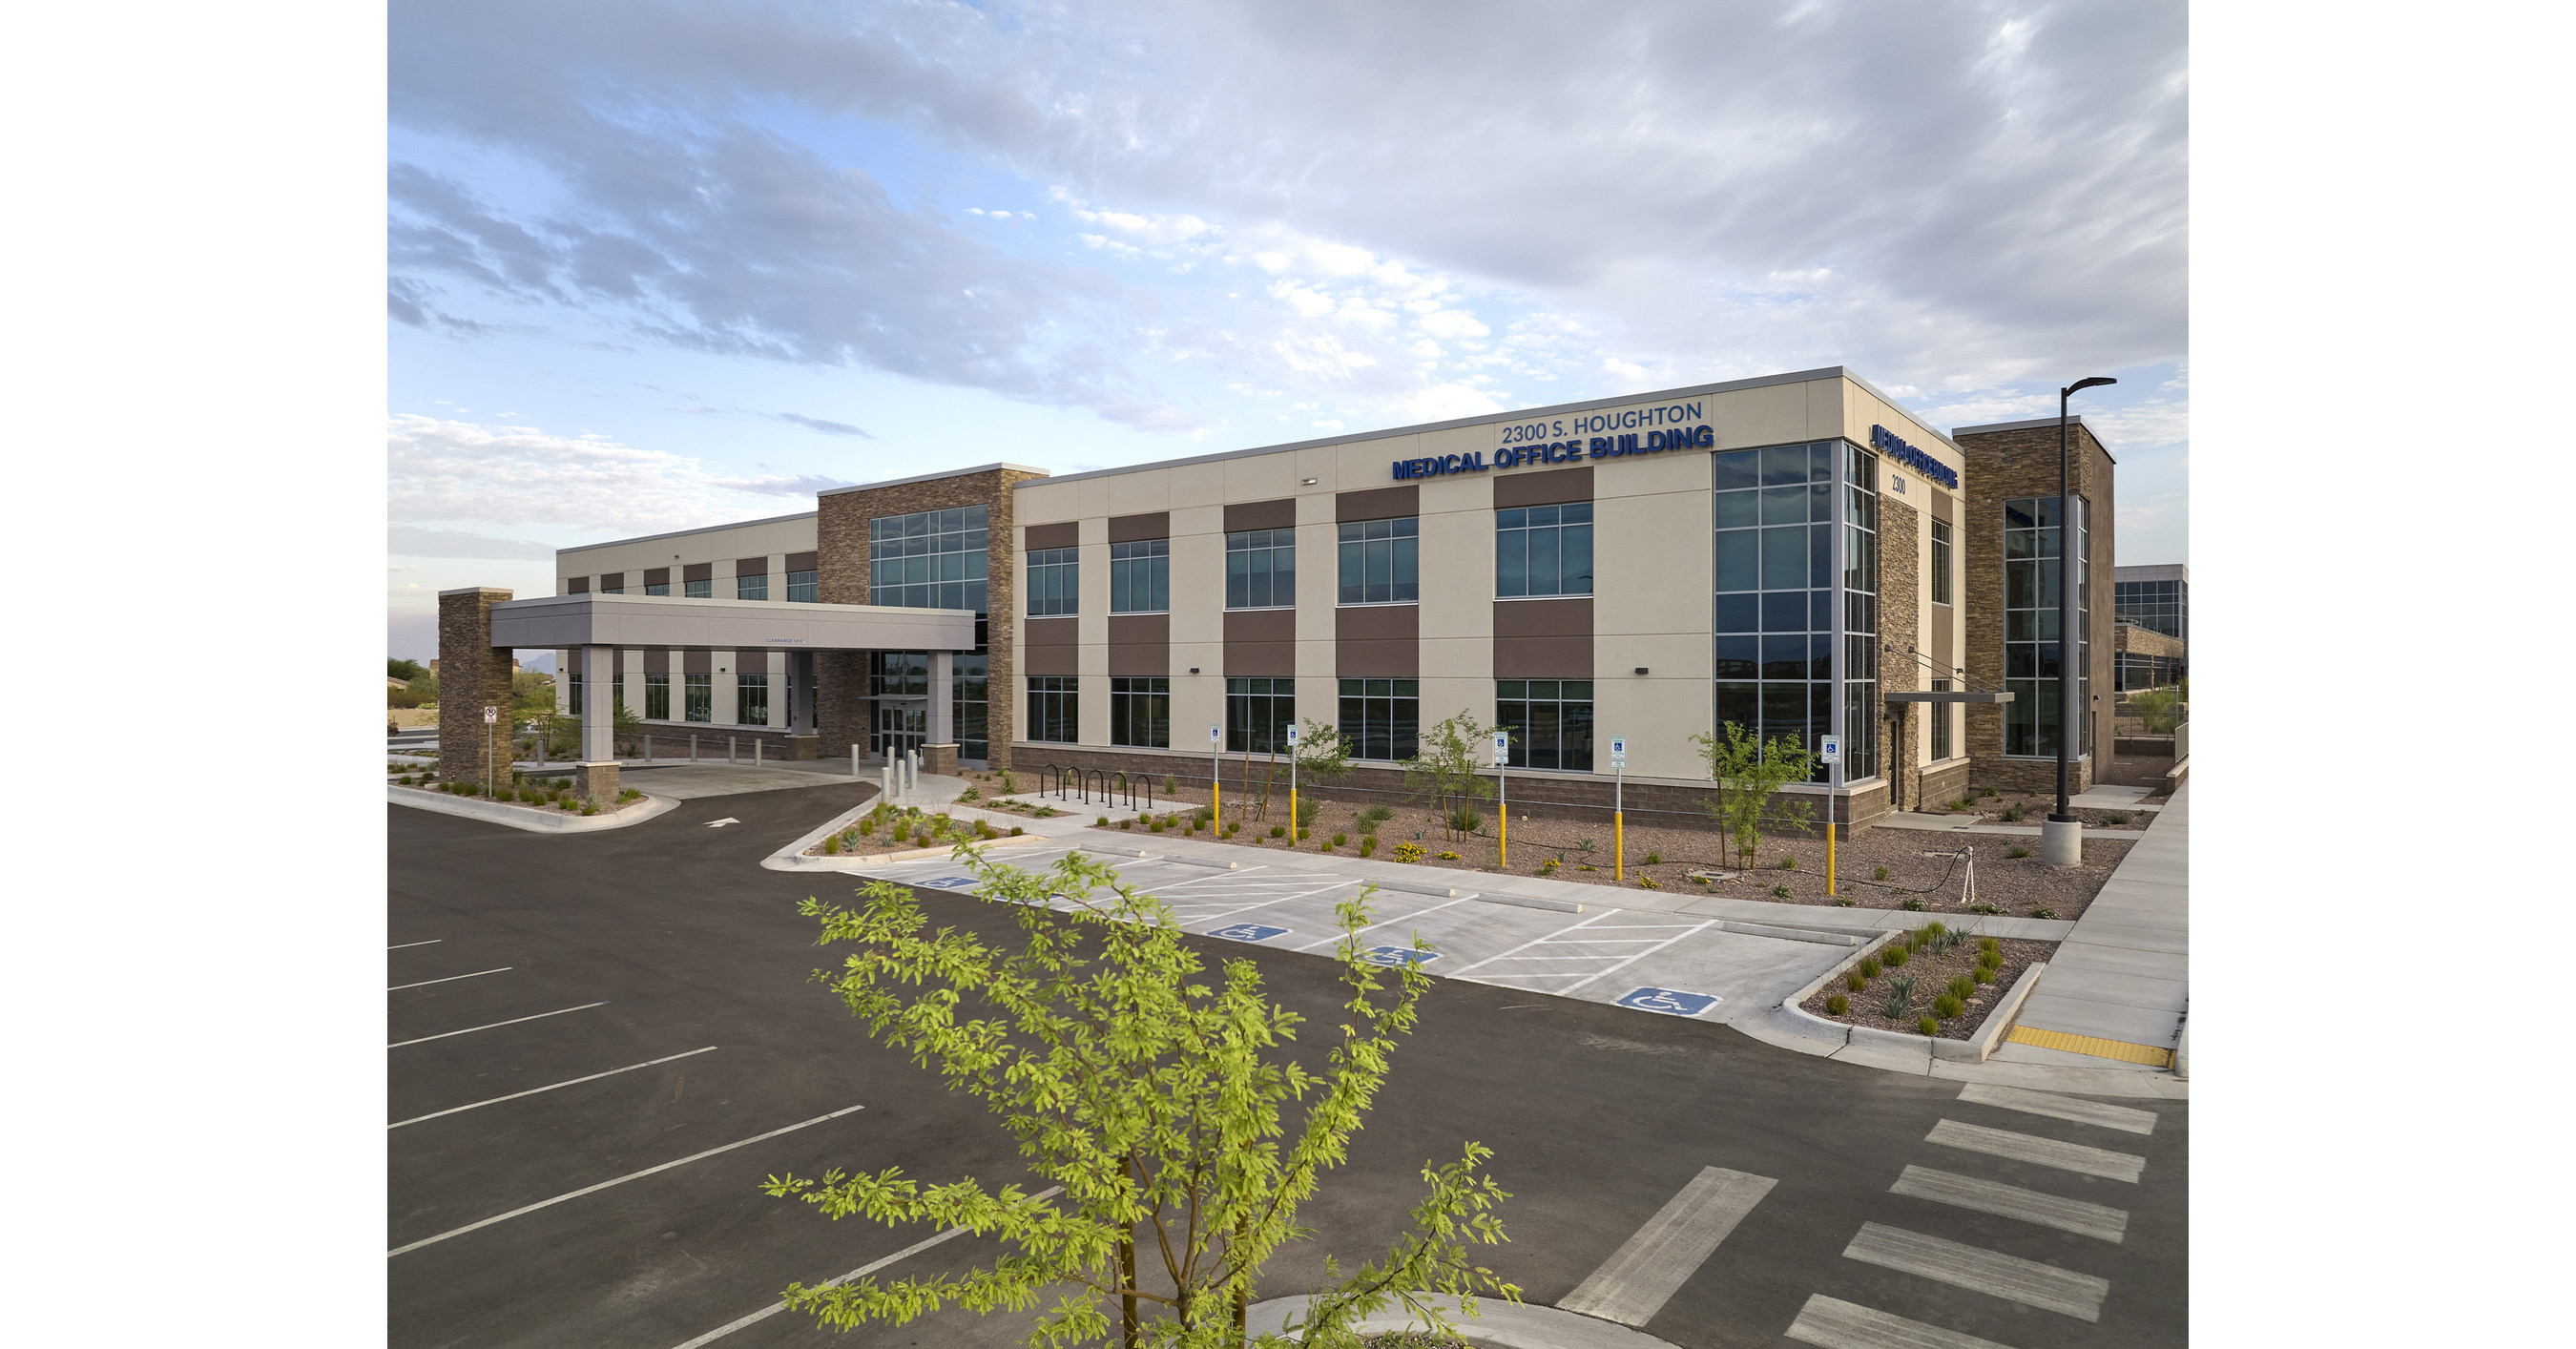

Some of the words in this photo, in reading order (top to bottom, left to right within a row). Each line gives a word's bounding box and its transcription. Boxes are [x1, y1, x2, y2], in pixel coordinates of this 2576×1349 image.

[1503, 423, 1547, 444] 2300
[1552, 421, 1568, 437] S.
[1574, 402, 1702, 434] HOUGHTON
[1392, 451, 1488, 480] MEDICAL
[1494, 440, 1583, 468] OFFICE
[1589, 425, 1714, 458] BUILDING
[1872, 425, 1908, 463] MEDICAL
[1909, 446, 1934, 475] OFFICE
[1892, 474, 1906, 495] 2300
